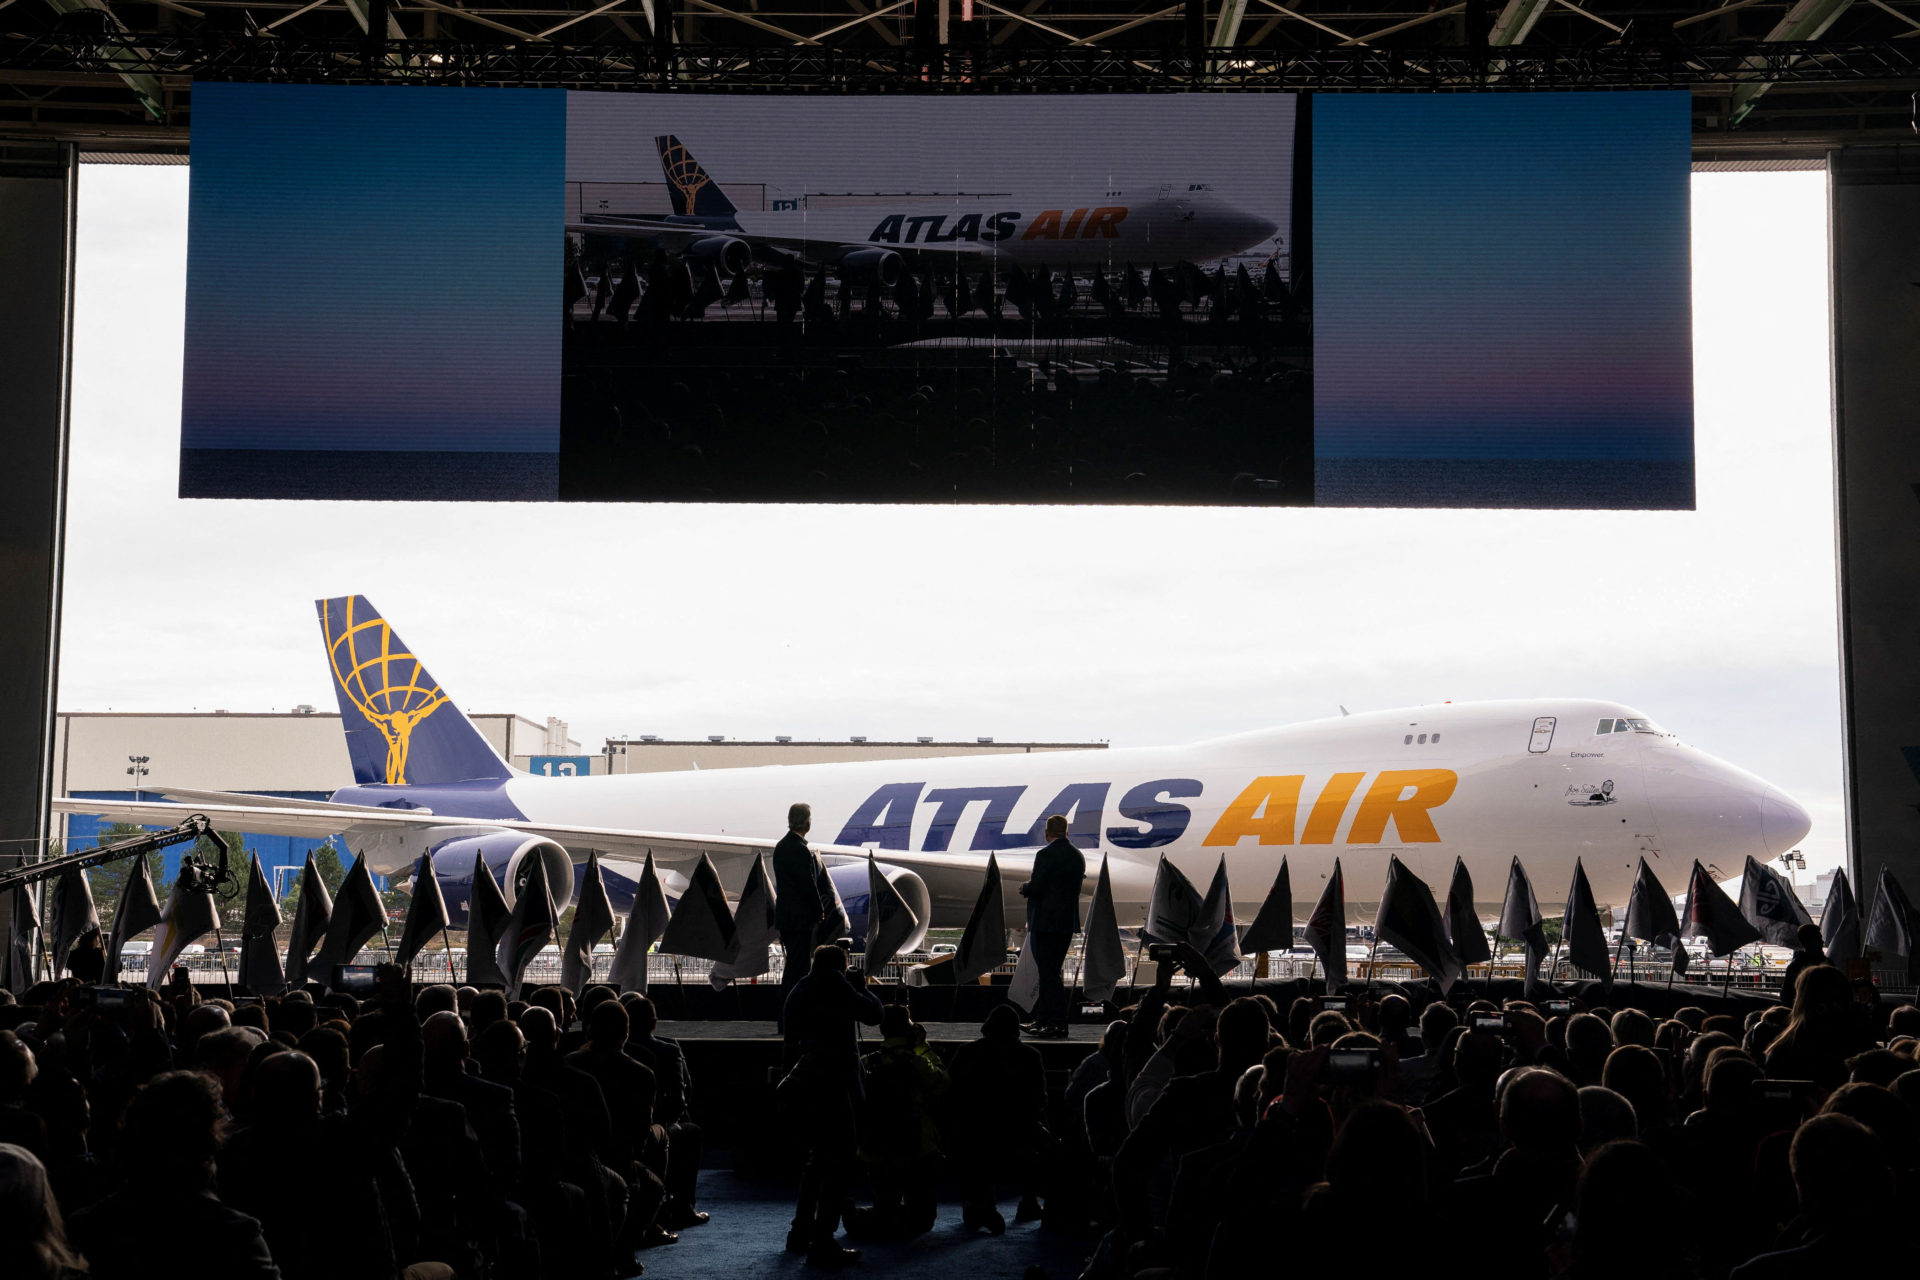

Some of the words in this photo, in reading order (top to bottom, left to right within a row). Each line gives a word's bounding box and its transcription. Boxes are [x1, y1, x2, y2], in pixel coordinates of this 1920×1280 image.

[868, 212, 1022, 244] ATLAS
[1021, 206, 1128, 240] AIR
[1570, 751, 1604, 759] Empower
[833, 778, 1204, 852] ATLAS
[1201, 768, 1459, 847] AIR
